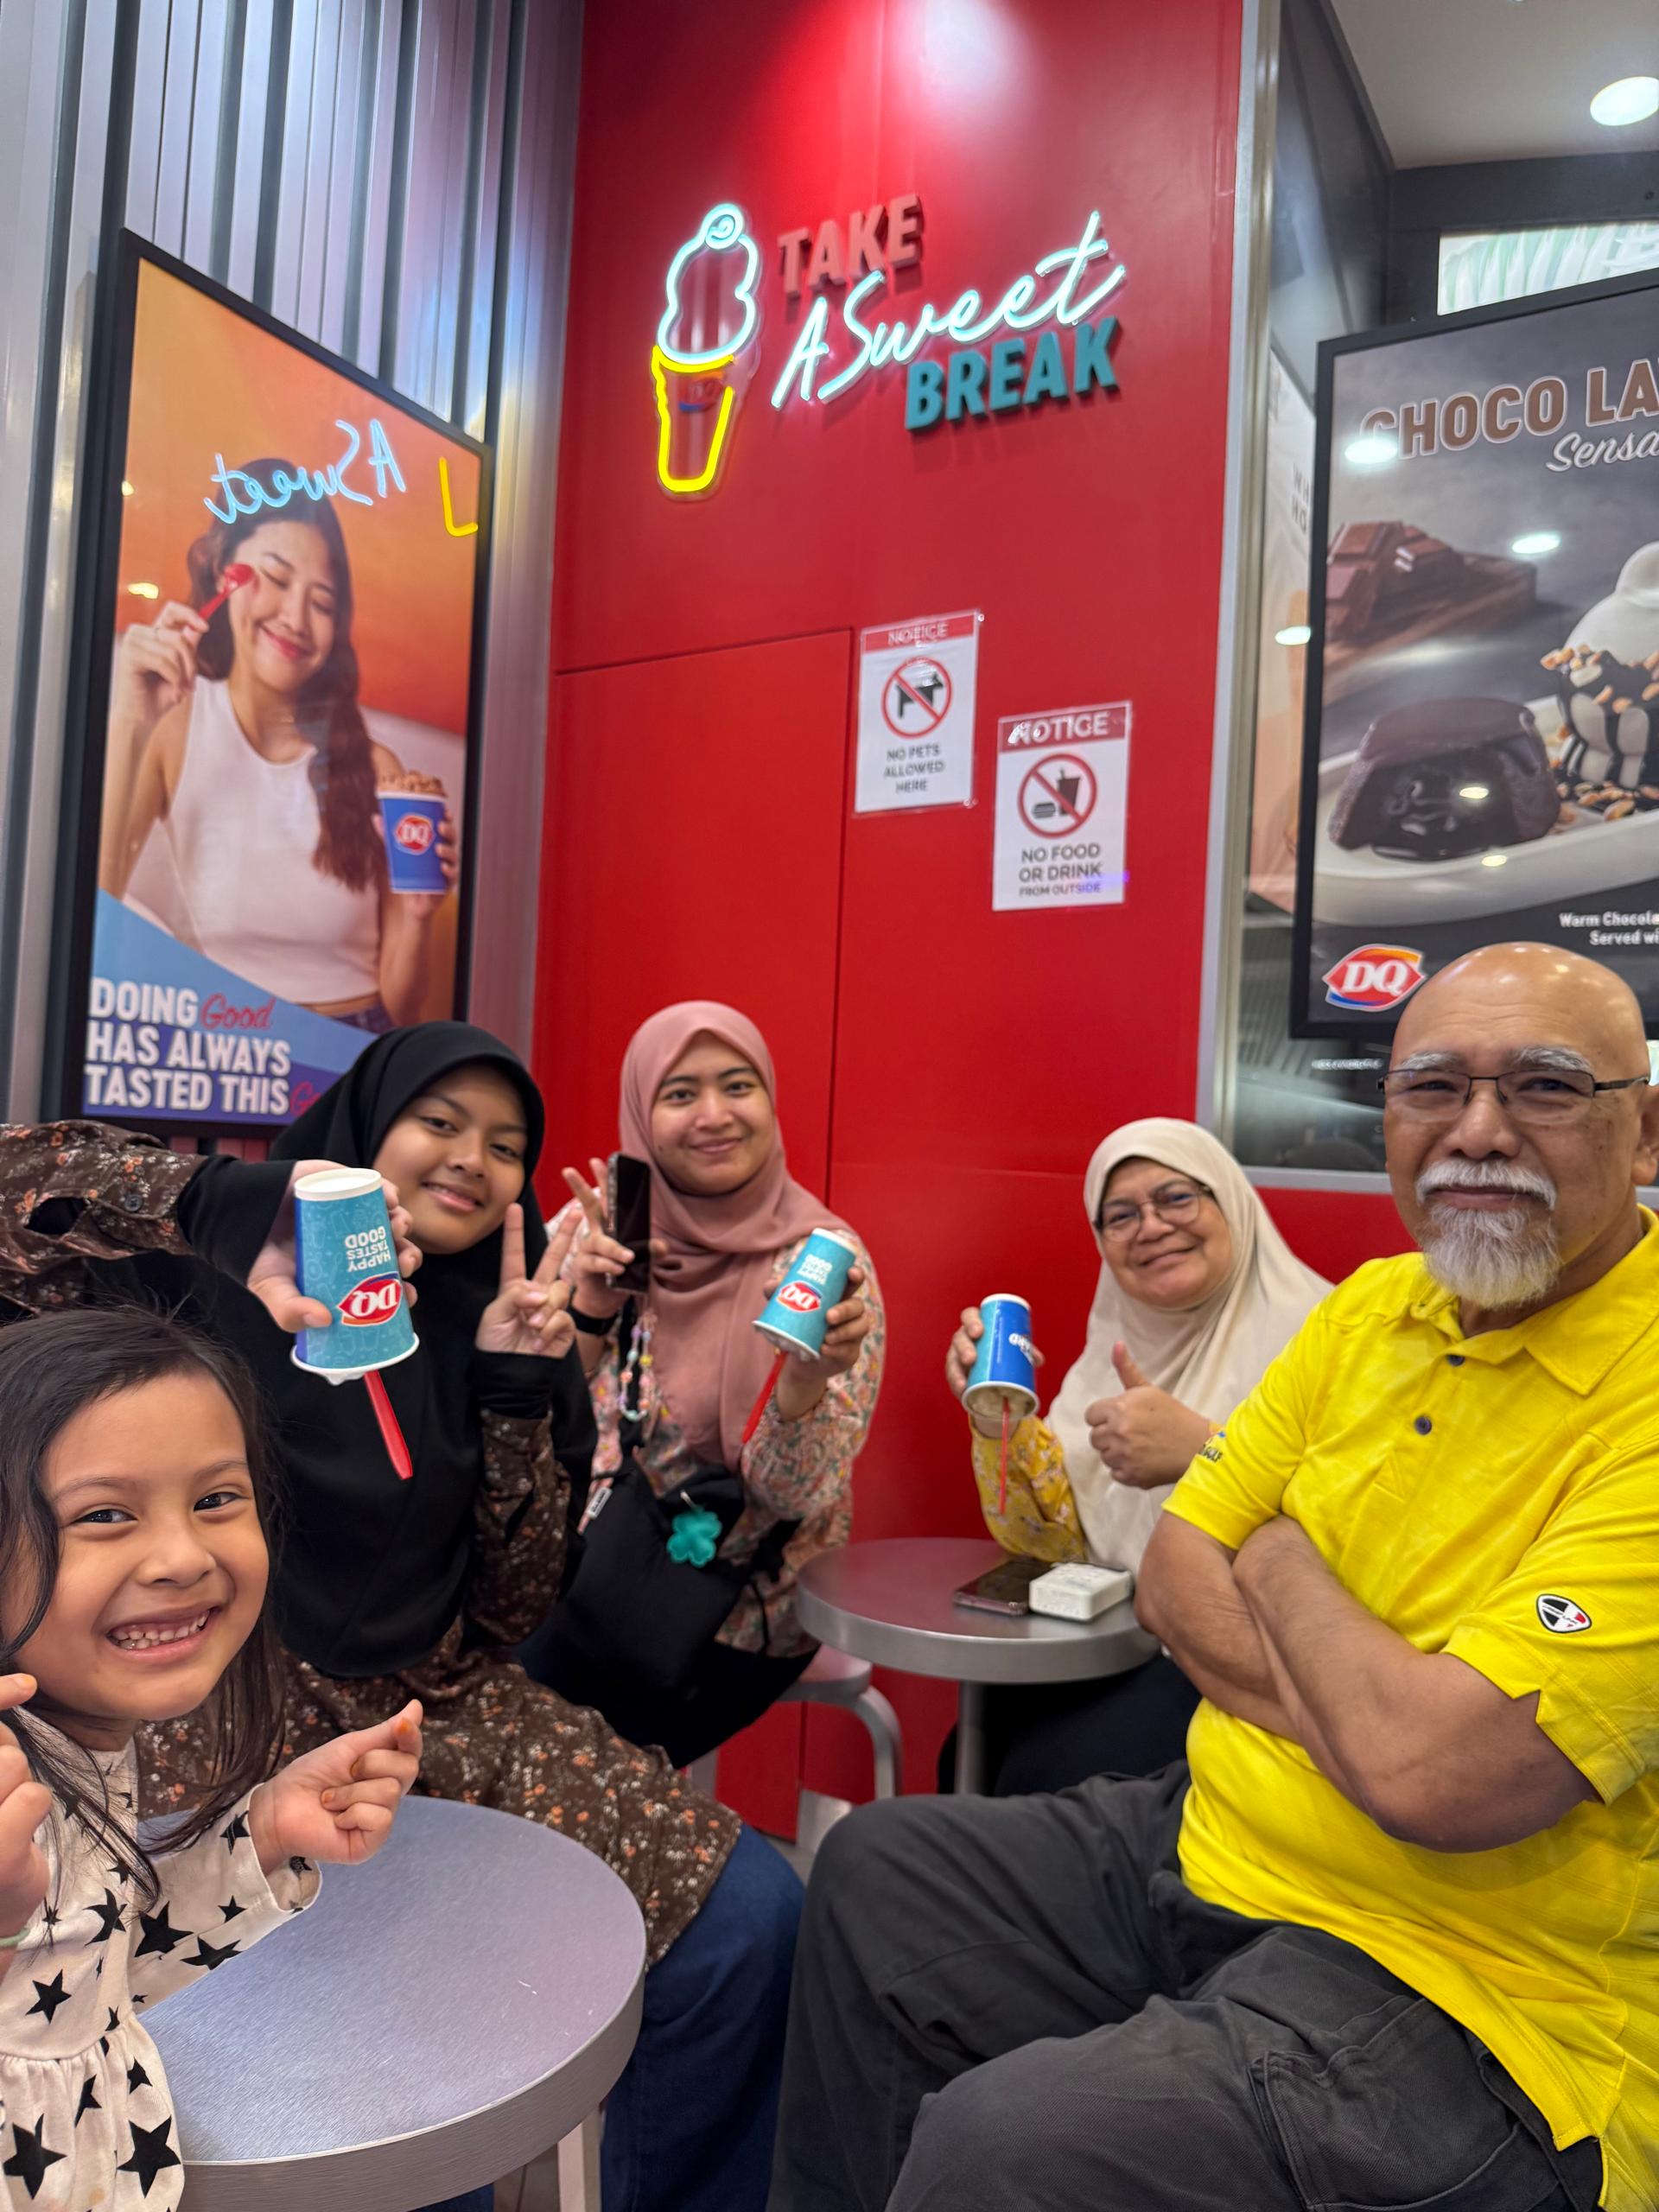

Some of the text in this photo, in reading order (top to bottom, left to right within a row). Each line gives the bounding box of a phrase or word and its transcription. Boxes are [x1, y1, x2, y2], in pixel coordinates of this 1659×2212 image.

[778, 193, 922, 294] TAKE
[771, 210, 1127, 410] A Sweet
[905, 317, 1121, 431] BREAK
[1360, 376, 1567, 460] CHOCO
[1586, 357, 1659, 427] LA
[887, 622, 949, 645] NOTICE
[1007, 711, 1109, 747] NOTICE
[887, 744, 940, 761] NO PETS
[883, 760, 945, 779] ALLOWED
[895, 779, 927, 793] HERE
[402, 822, 429, 843] DQ
[1021, 843, 1101, 863] NO FOOD
[1019, 863, 1102, 883] OR DRINK
[1019, 883, 1101, 897] FROM OUTSIDE
[1559, 912, 1600, 927] Warm
[1589, 929, 1641, 945] Served
[1342, 959, 1409, 997] DQ
[88, 977, 276, 1030] DOING Good
[86, 1020, 292, 1077] HAS ALWAYS
[84, 1064, 213, 1111] TASTED
[219, 1075, 291, 1116] THIS
[345, 1225, 386, 1248] GOOD
[346, 1240, 389, 1261] TASTES
[347, 1249, 391, 1272] HAPPY
[351, 1282, 397, 1317] DQ
[783, 1285, 816, 1308] DQ
